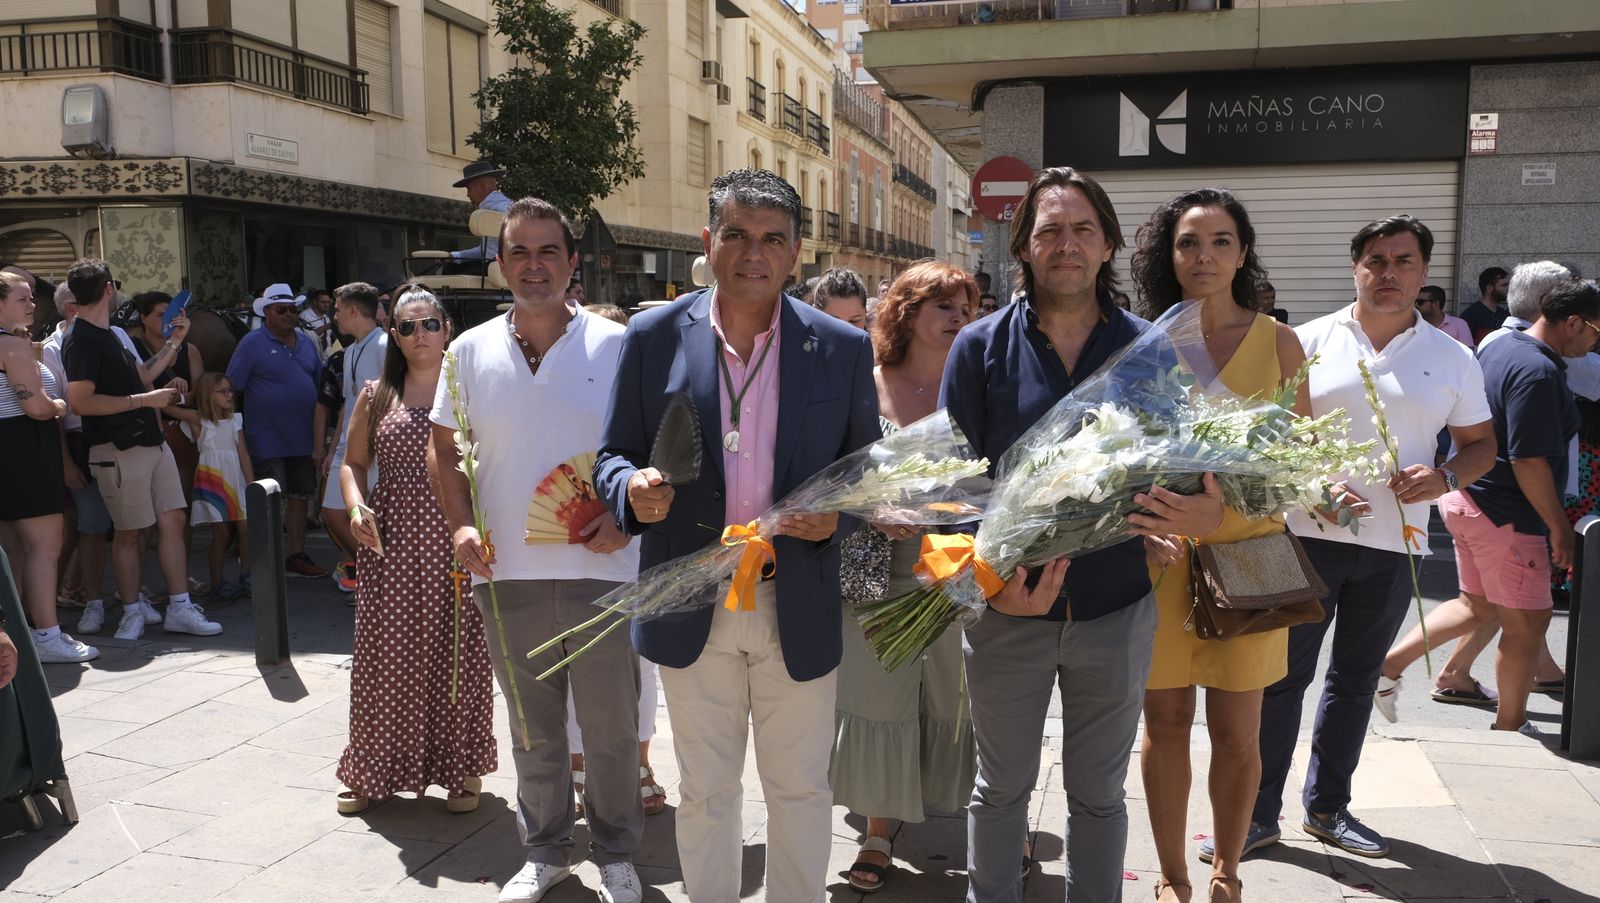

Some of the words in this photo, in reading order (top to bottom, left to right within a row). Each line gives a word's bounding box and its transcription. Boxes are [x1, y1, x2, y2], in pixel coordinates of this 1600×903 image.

[1207, 95, 1294, 118] MAÑAS
[1308, 94, 1385, 115] CANO
[1207, 118, 1383, 134] INMOBILIARIA
